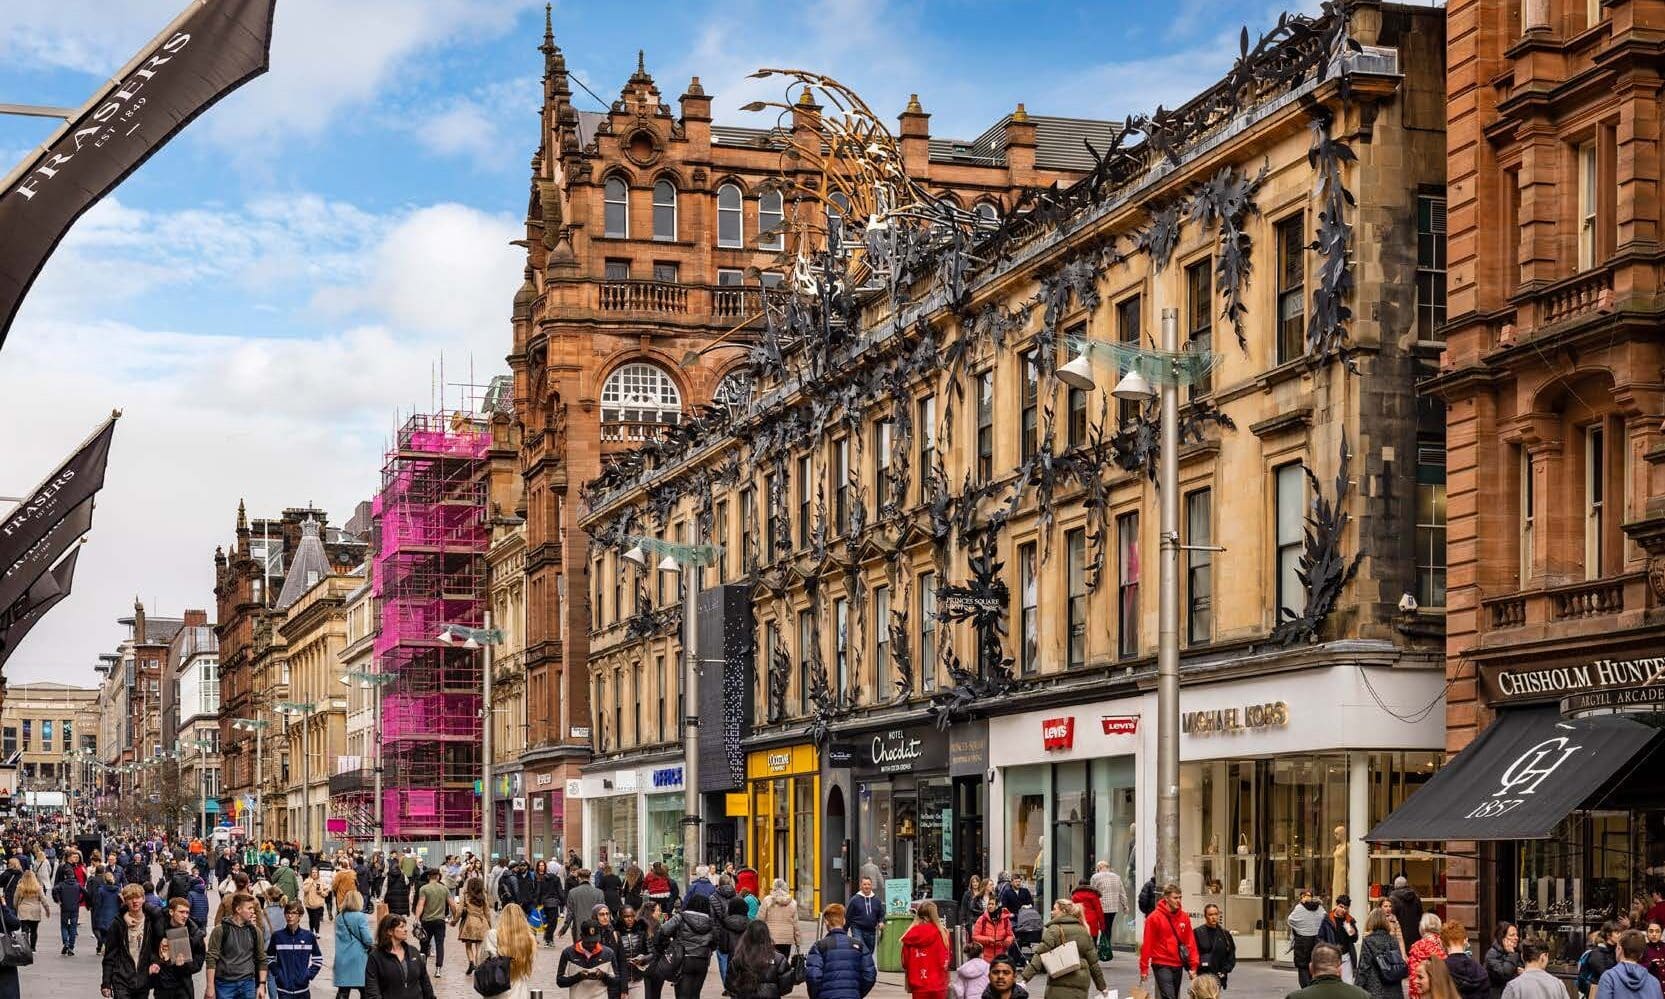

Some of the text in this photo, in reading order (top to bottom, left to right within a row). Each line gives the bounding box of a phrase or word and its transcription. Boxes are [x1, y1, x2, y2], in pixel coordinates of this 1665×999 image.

[16, 32, 191, 200] FRASERS
[94, 97, 146, 147] EST 1849
[4, 469, 76, 536] FRASERS
[1498, 657, 1665, 696] CHISHOLM HUNTE
[1581, 688, 1665, 707] ARGYLL ARCADE
[1182, 701, 1288, 733] MICHAEL KORS
[888, 730, 904, 740] HOTEL
[1464, 799, 1525, 819] 1857
